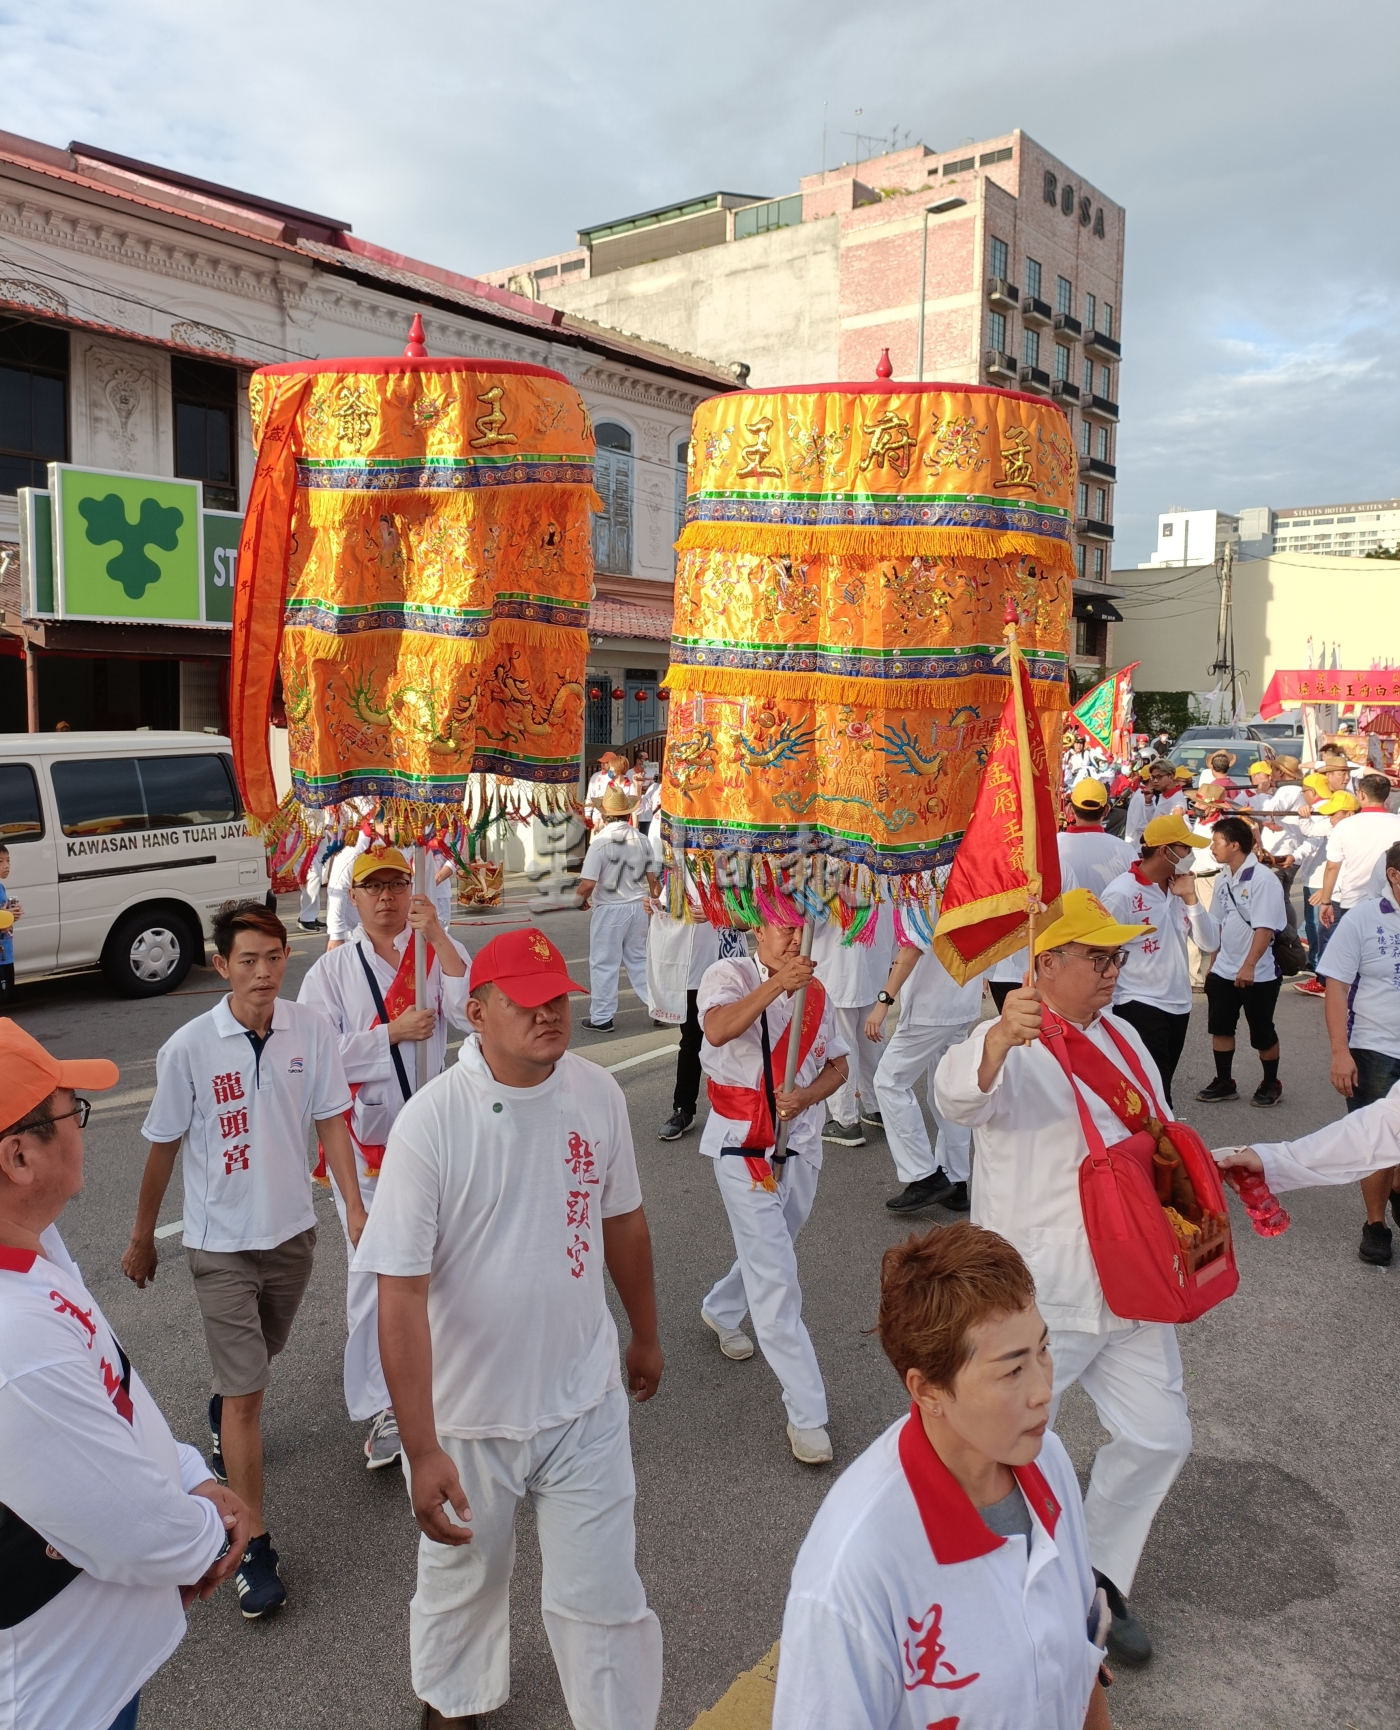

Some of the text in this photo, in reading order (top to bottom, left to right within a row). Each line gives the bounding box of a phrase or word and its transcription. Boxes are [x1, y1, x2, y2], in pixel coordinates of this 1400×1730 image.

[1043, 170, 1105, 240] ROSA
[1293, 509, 1322, 517] STRAITS
[1325, 506, 1347, 514] HOTEL
[213, 546, 238, 588] ST
[67, 823, 247, 857] KAWASAN HANG TUAH JAYA
[211, 1071, 251, 1176] 龍頭宮
[564, 1131, 601, 1280] 龍頭宮
[903, 1603, 981, 1730] 送
